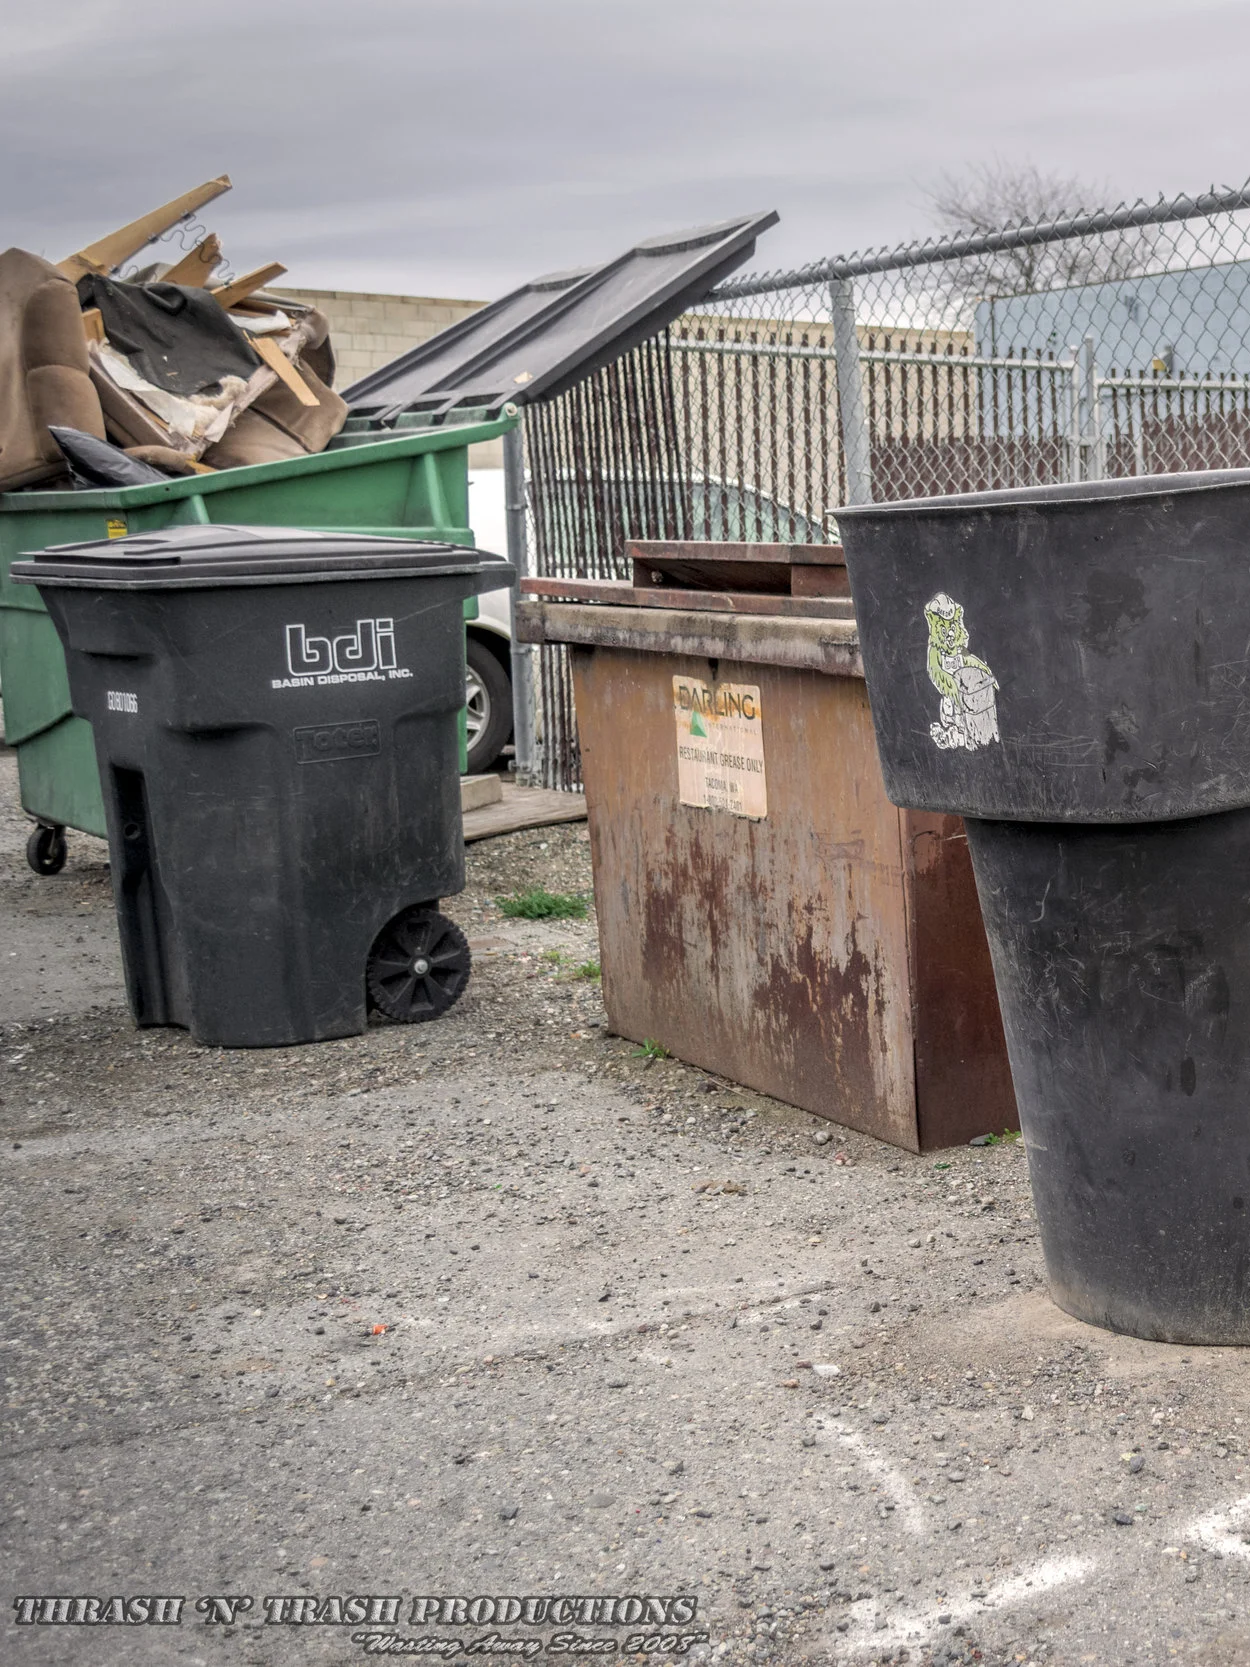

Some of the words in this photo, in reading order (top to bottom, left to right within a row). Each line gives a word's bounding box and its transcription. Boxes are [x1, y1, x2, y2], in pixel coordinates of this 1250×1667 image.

[286, 618, 397, 676] bdi
[272, 677, 314, 689] BASIN
[317, 671, 386, 685] DISPOSAL,
[388, 668, 413, 679] INC.
[678, 685, 756, 720] DARLING
[679, 746, 718, 765] RESTAURANT
[720, 753, 745, 771] GREASE
[746, 757, 763, 774] ONLY
